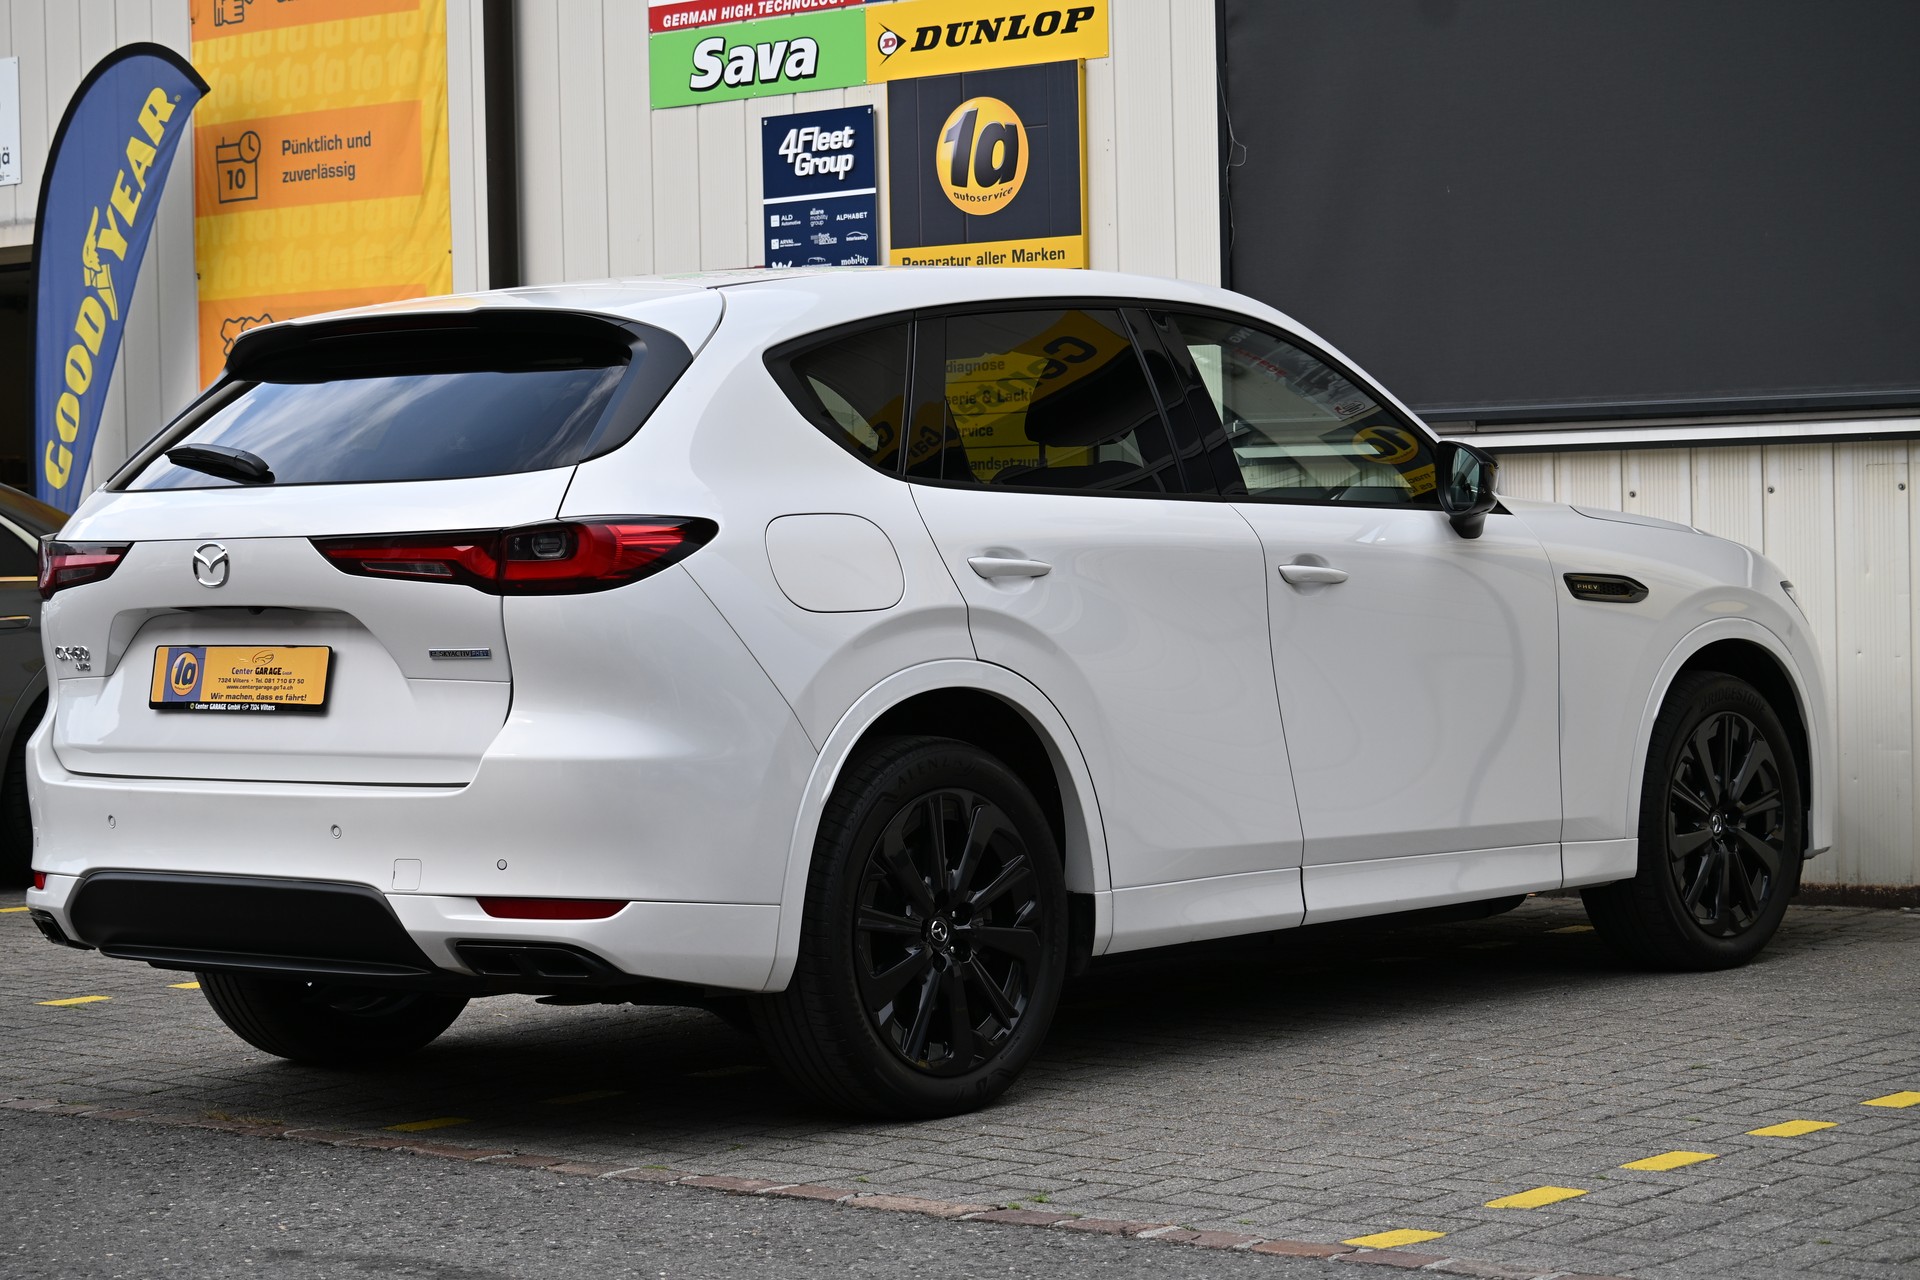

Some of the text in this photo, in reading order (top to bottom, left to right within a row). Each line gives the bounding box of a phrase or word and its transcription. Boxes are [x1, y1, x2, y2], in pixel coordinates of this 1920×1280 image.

[662, 0, 846, 28] GERMAN HIGH TECHNOL
[910, 6, 1095, 52] DUNLOP
[689, 36, 819, 91] Sava
[282, 131, 372, 156] Pünktlich und
[779, 126, 855, 163] 4Fleet
[944, 108, 1019, 188] 1a
[282, 161, 356, 183] zuverlässig
[794, 152, 854, 180] Group
[227, 168, 246, 190] 10
[953, 186, 1013, 202] autoservice
[781, 214, 794, 222] ALD
[836, 212, 868, 221] ALPHABET
[976, 251, 1007, 265] aller
[1011, 247, 1065, 263] Marken
[44, 87, 175, 490] GOODYEAR
[174, 657, 196, 685] 1a
[231, 667, 253, 675] Center
[255, 667, 282, 675] GARAGE
[210, 692, 224, 700] Wir
[225, 693, 255, 701] machen,
[285, 693, 307, 701] fährt!
